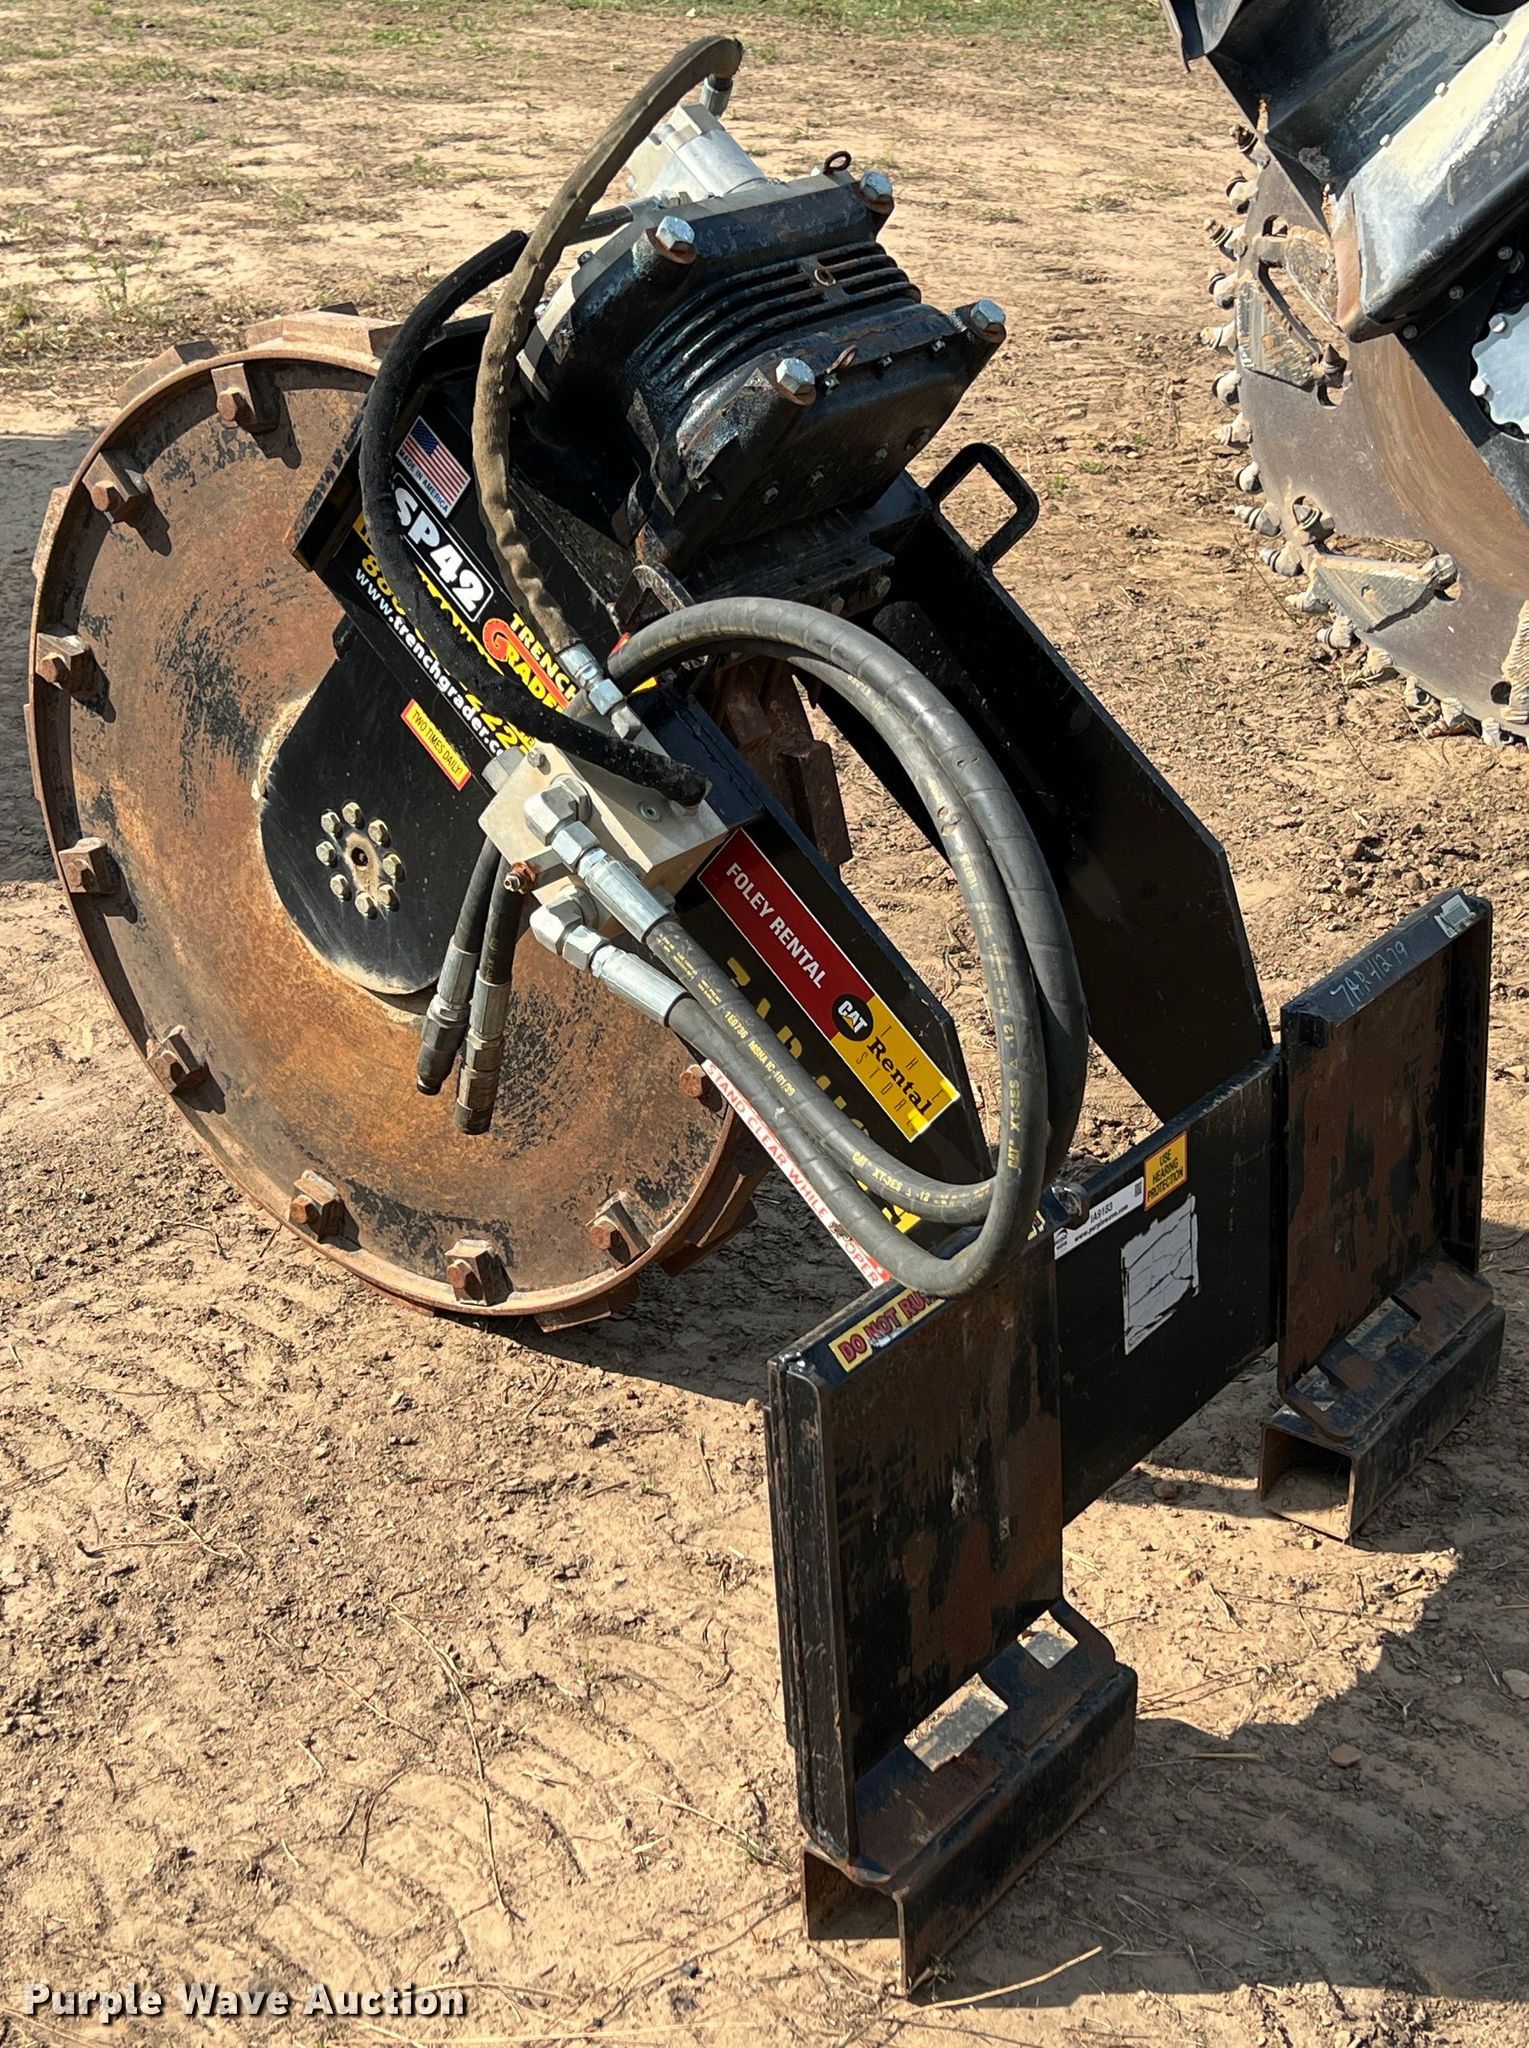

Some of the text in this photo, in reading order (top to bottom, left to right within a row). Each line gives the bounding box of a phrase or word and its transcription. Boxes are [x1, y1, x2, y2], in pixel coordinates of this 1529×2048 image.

[400, 448, 416, 471] MADE
[421, 478, 449, 513] AMERICA
[395, 487, 485, 612] SP42
[509, 612, 578, 701] TRENCH
[411, 709, 428, 732] TWO
[425, 727, 445, 755] TIMES
[725, 862, 831, 990] FOLEY RENTAL
[724, 1010, 749, 1039] 1E0736
[837, 1000, 868, 1033] CAT
[866, 1036, 933, 1116] Rental
[880, 1024, 945, 1102] THE
[704, 1064, 747, 1114] STAND
[747, 1115, 788, 1167] CLEAR
[787, 1169, 827, 1219] WHILE
[1152, 1157, 1180, 1184] HEARING
[1159, 1149, 1172, 1166] USE
[1147, 1166, 1184, 1202] PROTECTION
[837, 1333, 868, 1364] DO
[862, 1307, 902, 1340] NOT
